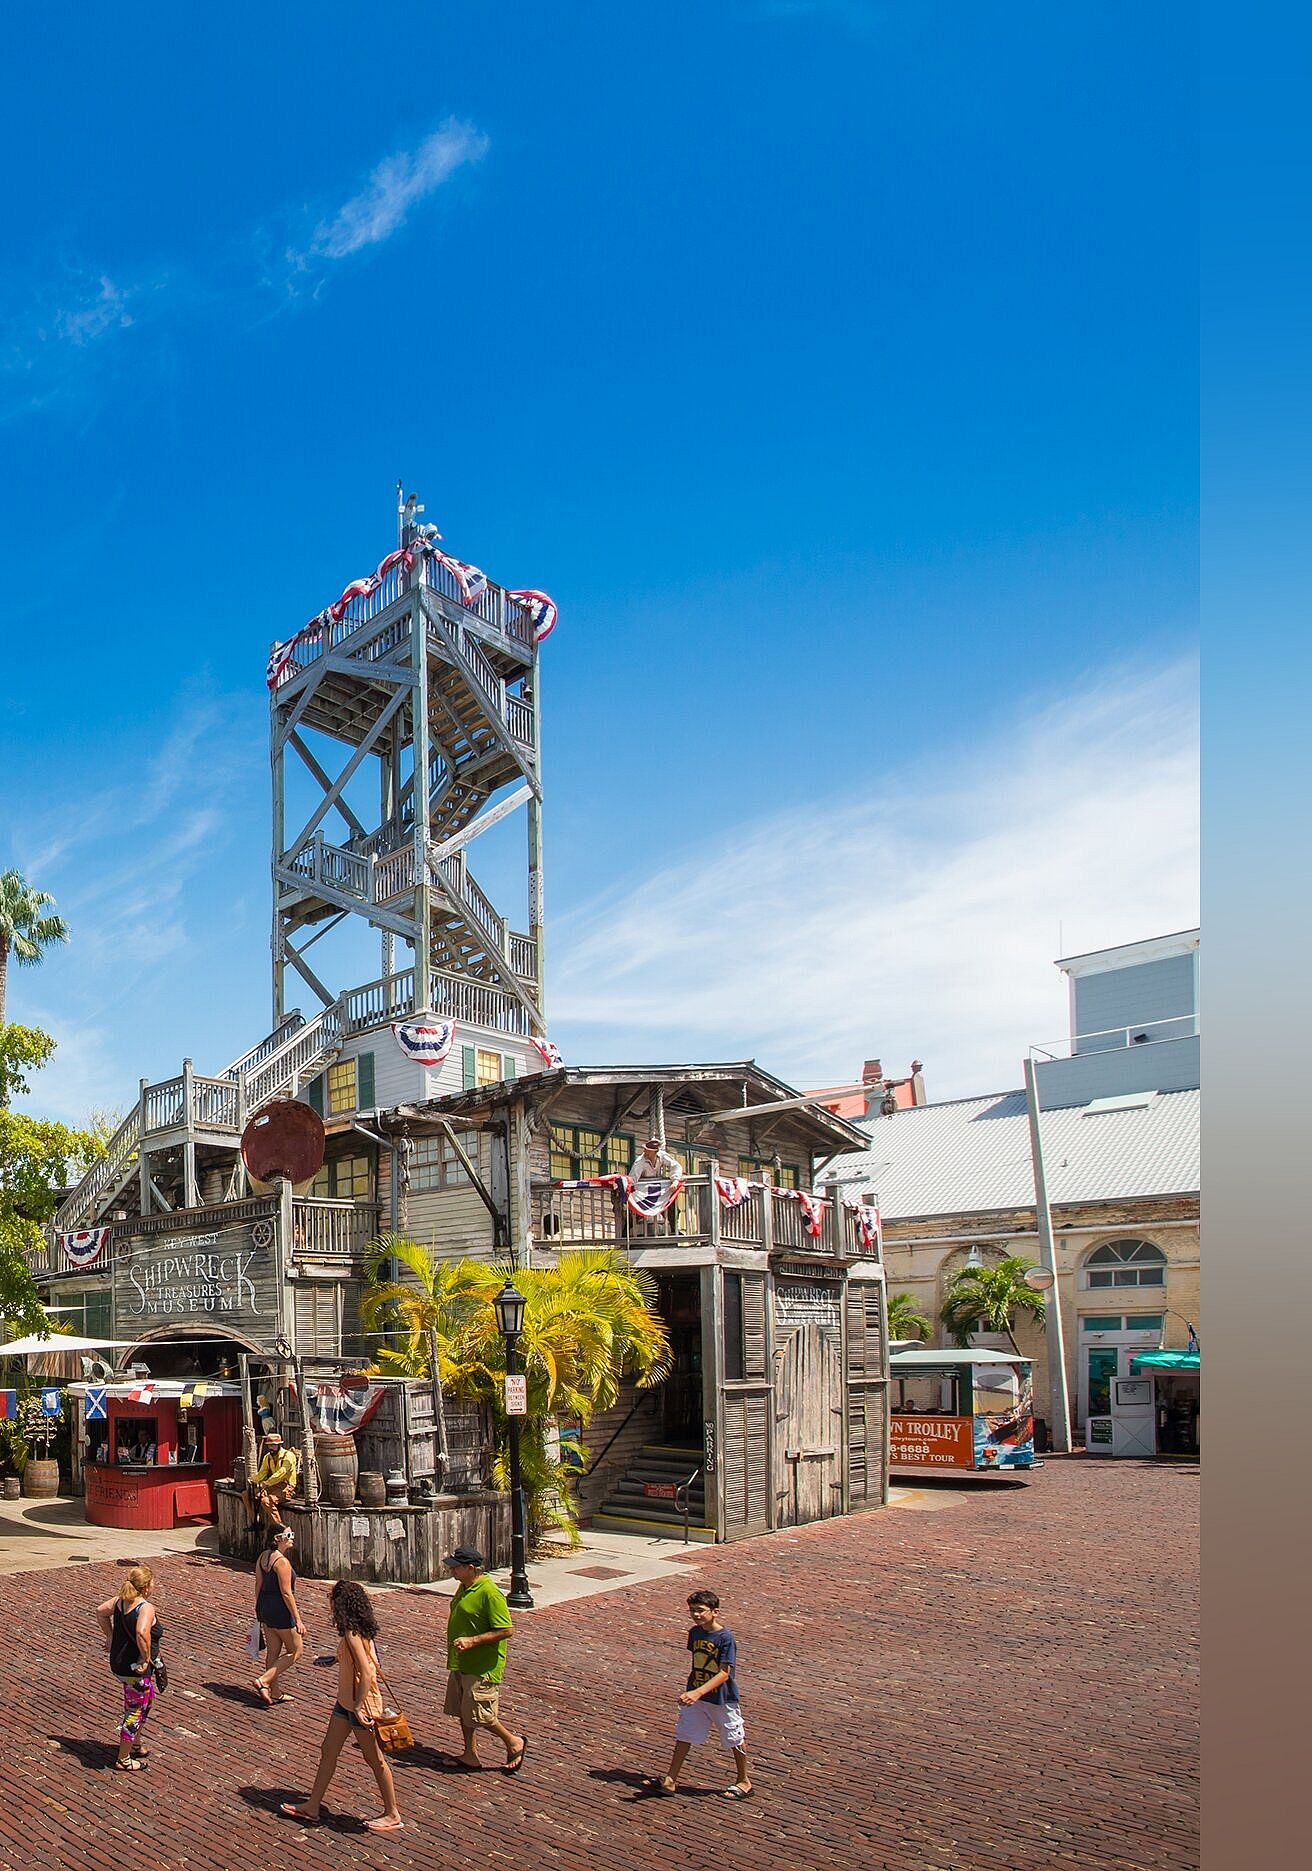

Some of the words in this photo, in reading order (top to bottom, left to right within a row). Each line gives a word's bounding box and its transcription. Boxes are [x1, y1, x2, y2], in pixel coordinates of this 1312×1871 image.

[129, 1251, 263, 1315] SHIPWRECK
[156, 1282, 223, 1300] TREASURES
[148, 1297, 233, 1314] MUSEUM
[907, 1421, 962, 1442] TROLLEY
[900, 1452, 927, 1461] BEST
[930, 1454, 955, 1463] TOUR
